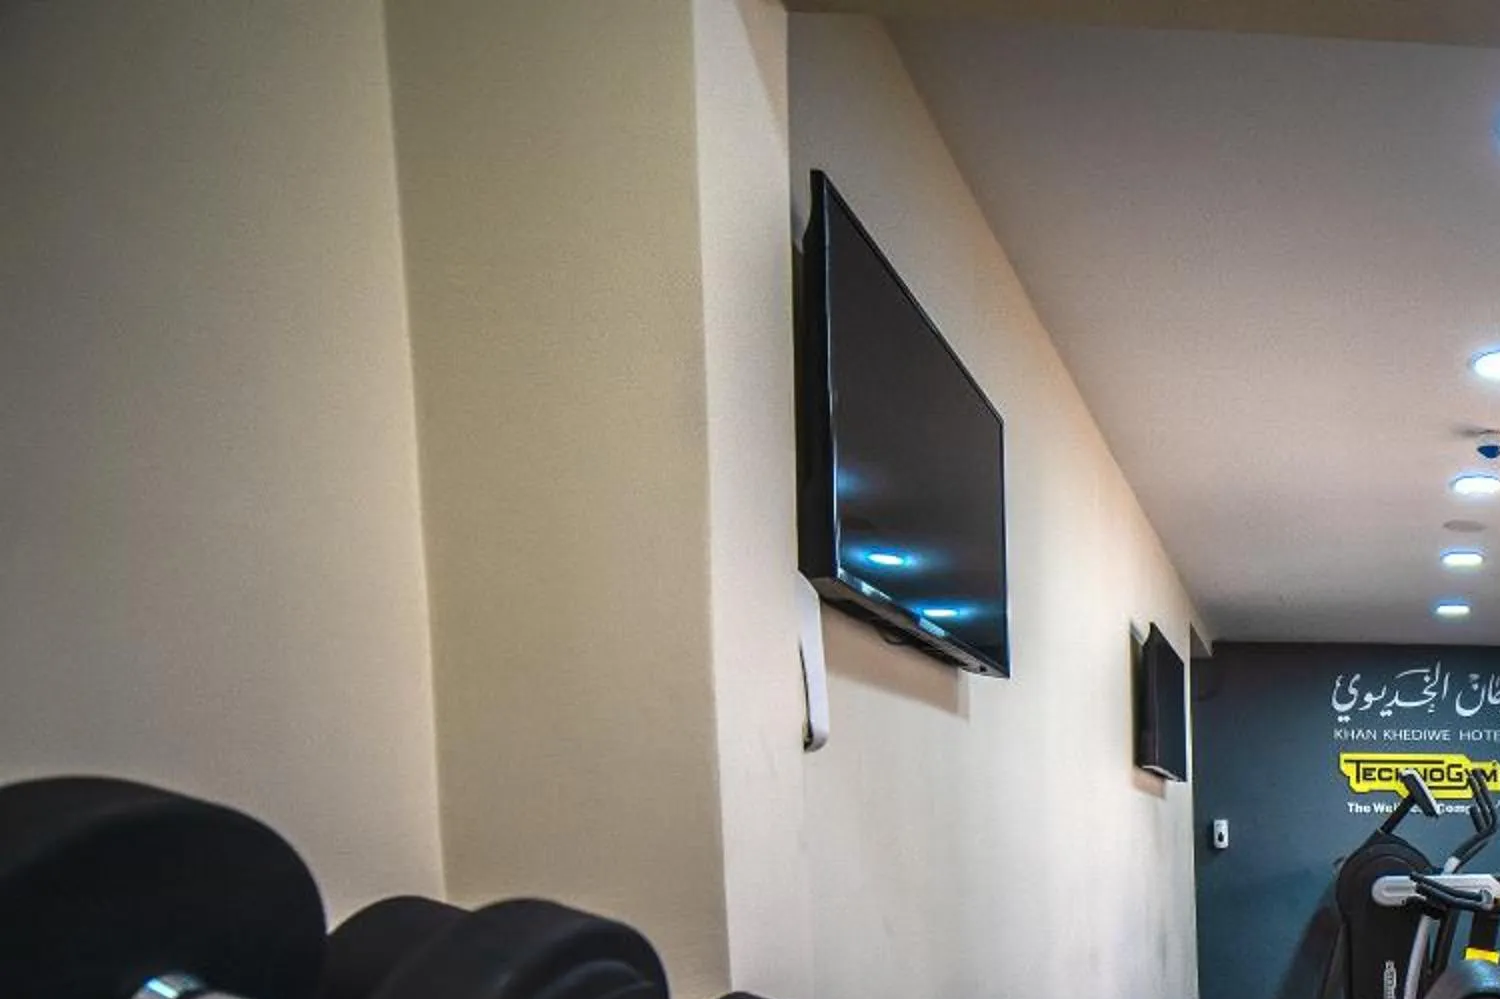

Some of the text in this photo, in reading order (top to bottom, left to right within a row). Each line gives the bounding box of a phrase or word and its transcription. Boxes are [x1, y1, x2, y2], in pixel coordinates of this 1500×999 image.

[1333, 729, 1378, 741] KHAN
[1383, 729, 1452, 741] KHEDIWE
[1347, 801, 1371, 813] The
